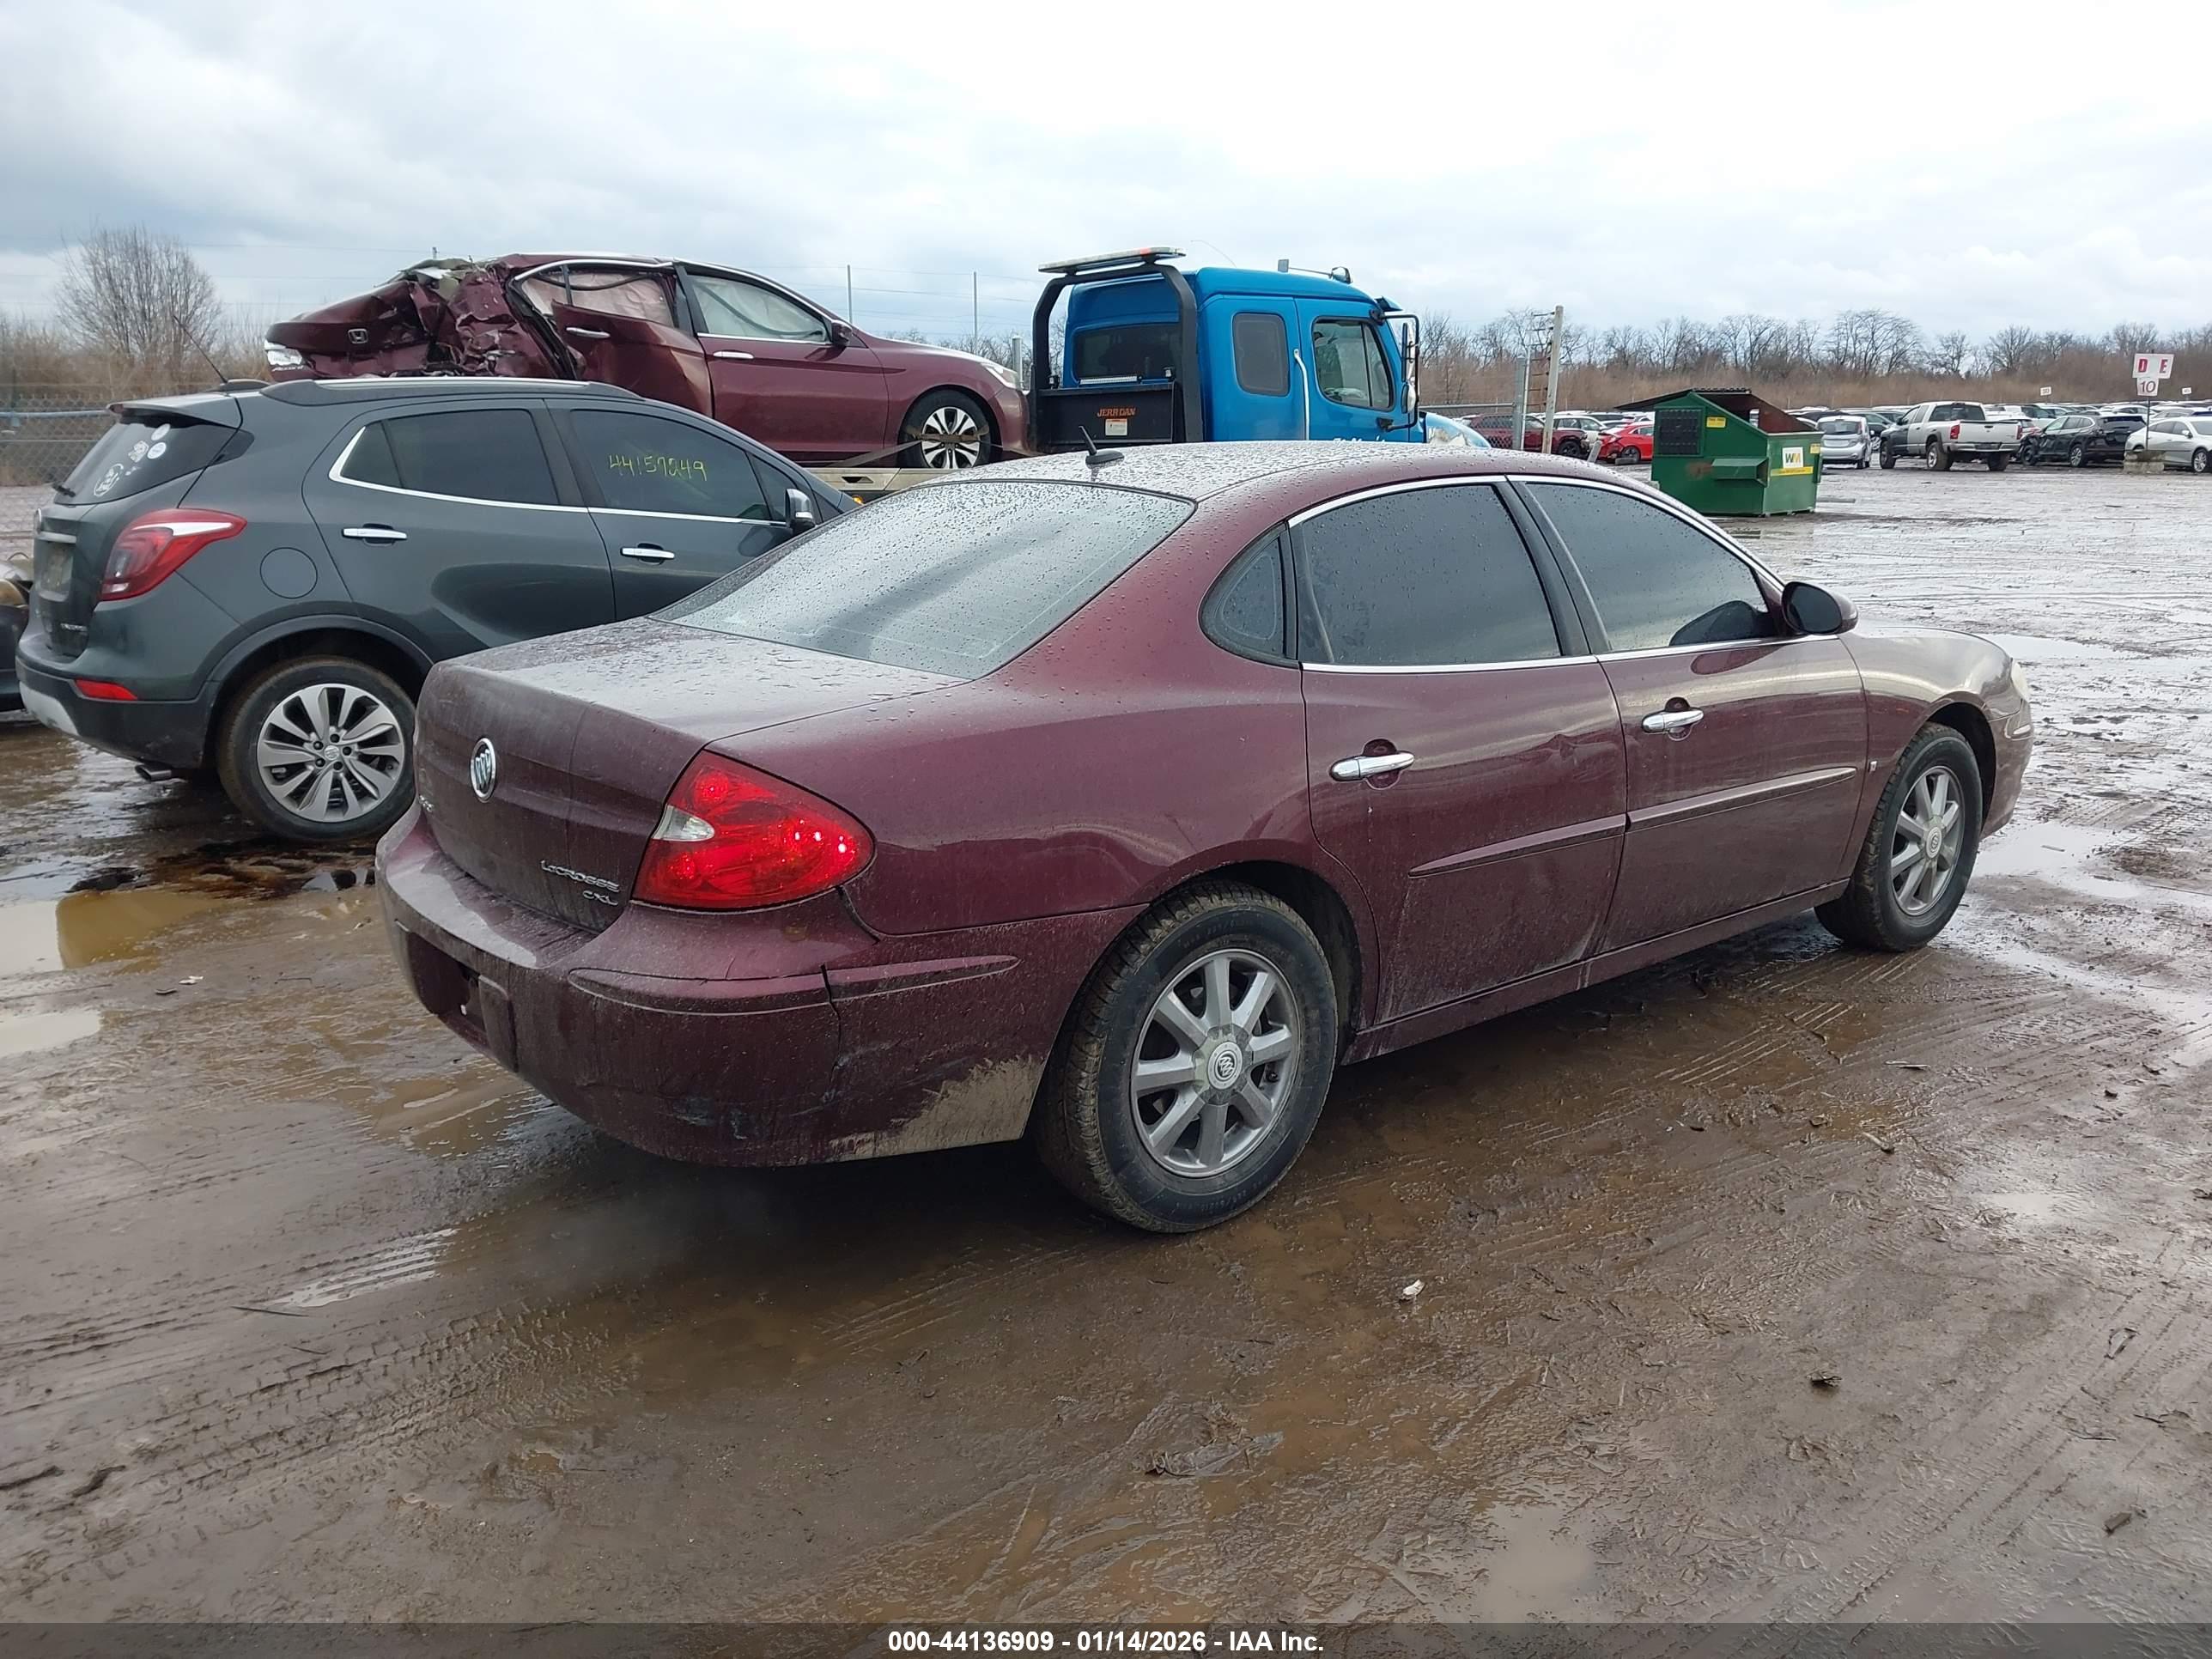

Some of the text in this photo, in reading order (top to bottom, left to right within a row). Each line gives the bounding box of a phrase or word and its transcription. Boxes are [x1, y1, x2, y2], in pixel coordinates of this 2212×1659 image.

[2138, 358, 2168, 374] D E
[2139, 380, 2156, 393] 10
[1785, 453, 1801, 464] WM
[582, 890, 619, 906] CXL
